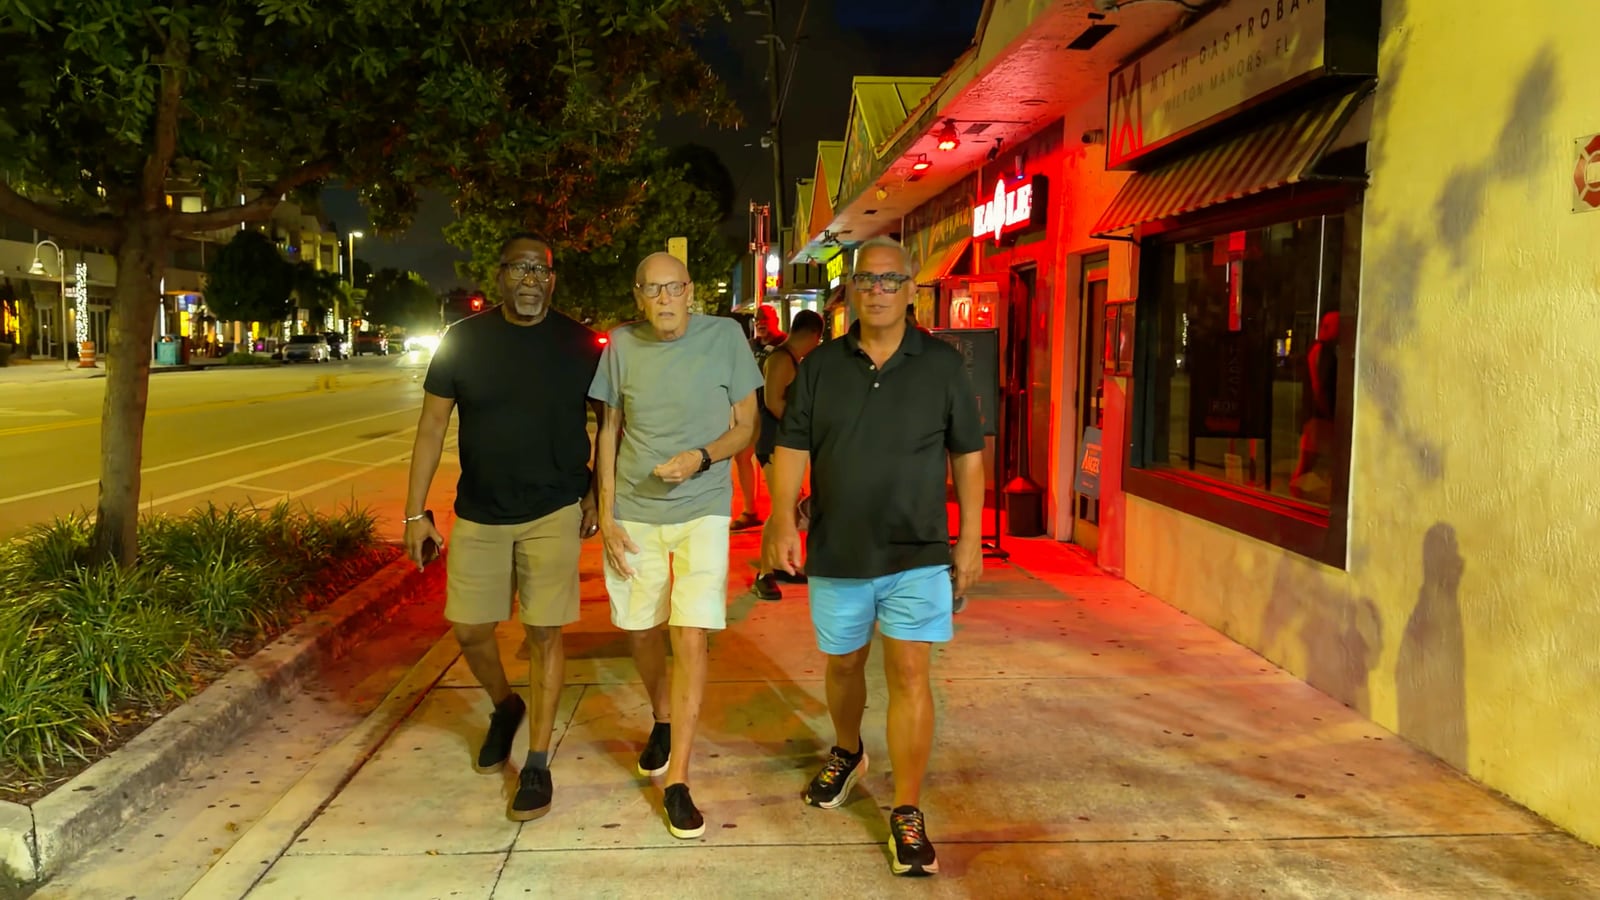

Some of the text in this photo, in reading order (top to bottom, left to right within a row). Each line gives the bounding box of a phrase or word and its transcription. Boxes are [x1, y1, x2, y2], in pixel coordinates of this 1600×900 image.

[1150, 0, 1315, 94] MYTH GASTROBA
[1163, 83, 1204, 113] WILTON
[1275, 37, 1290, 57] FL
